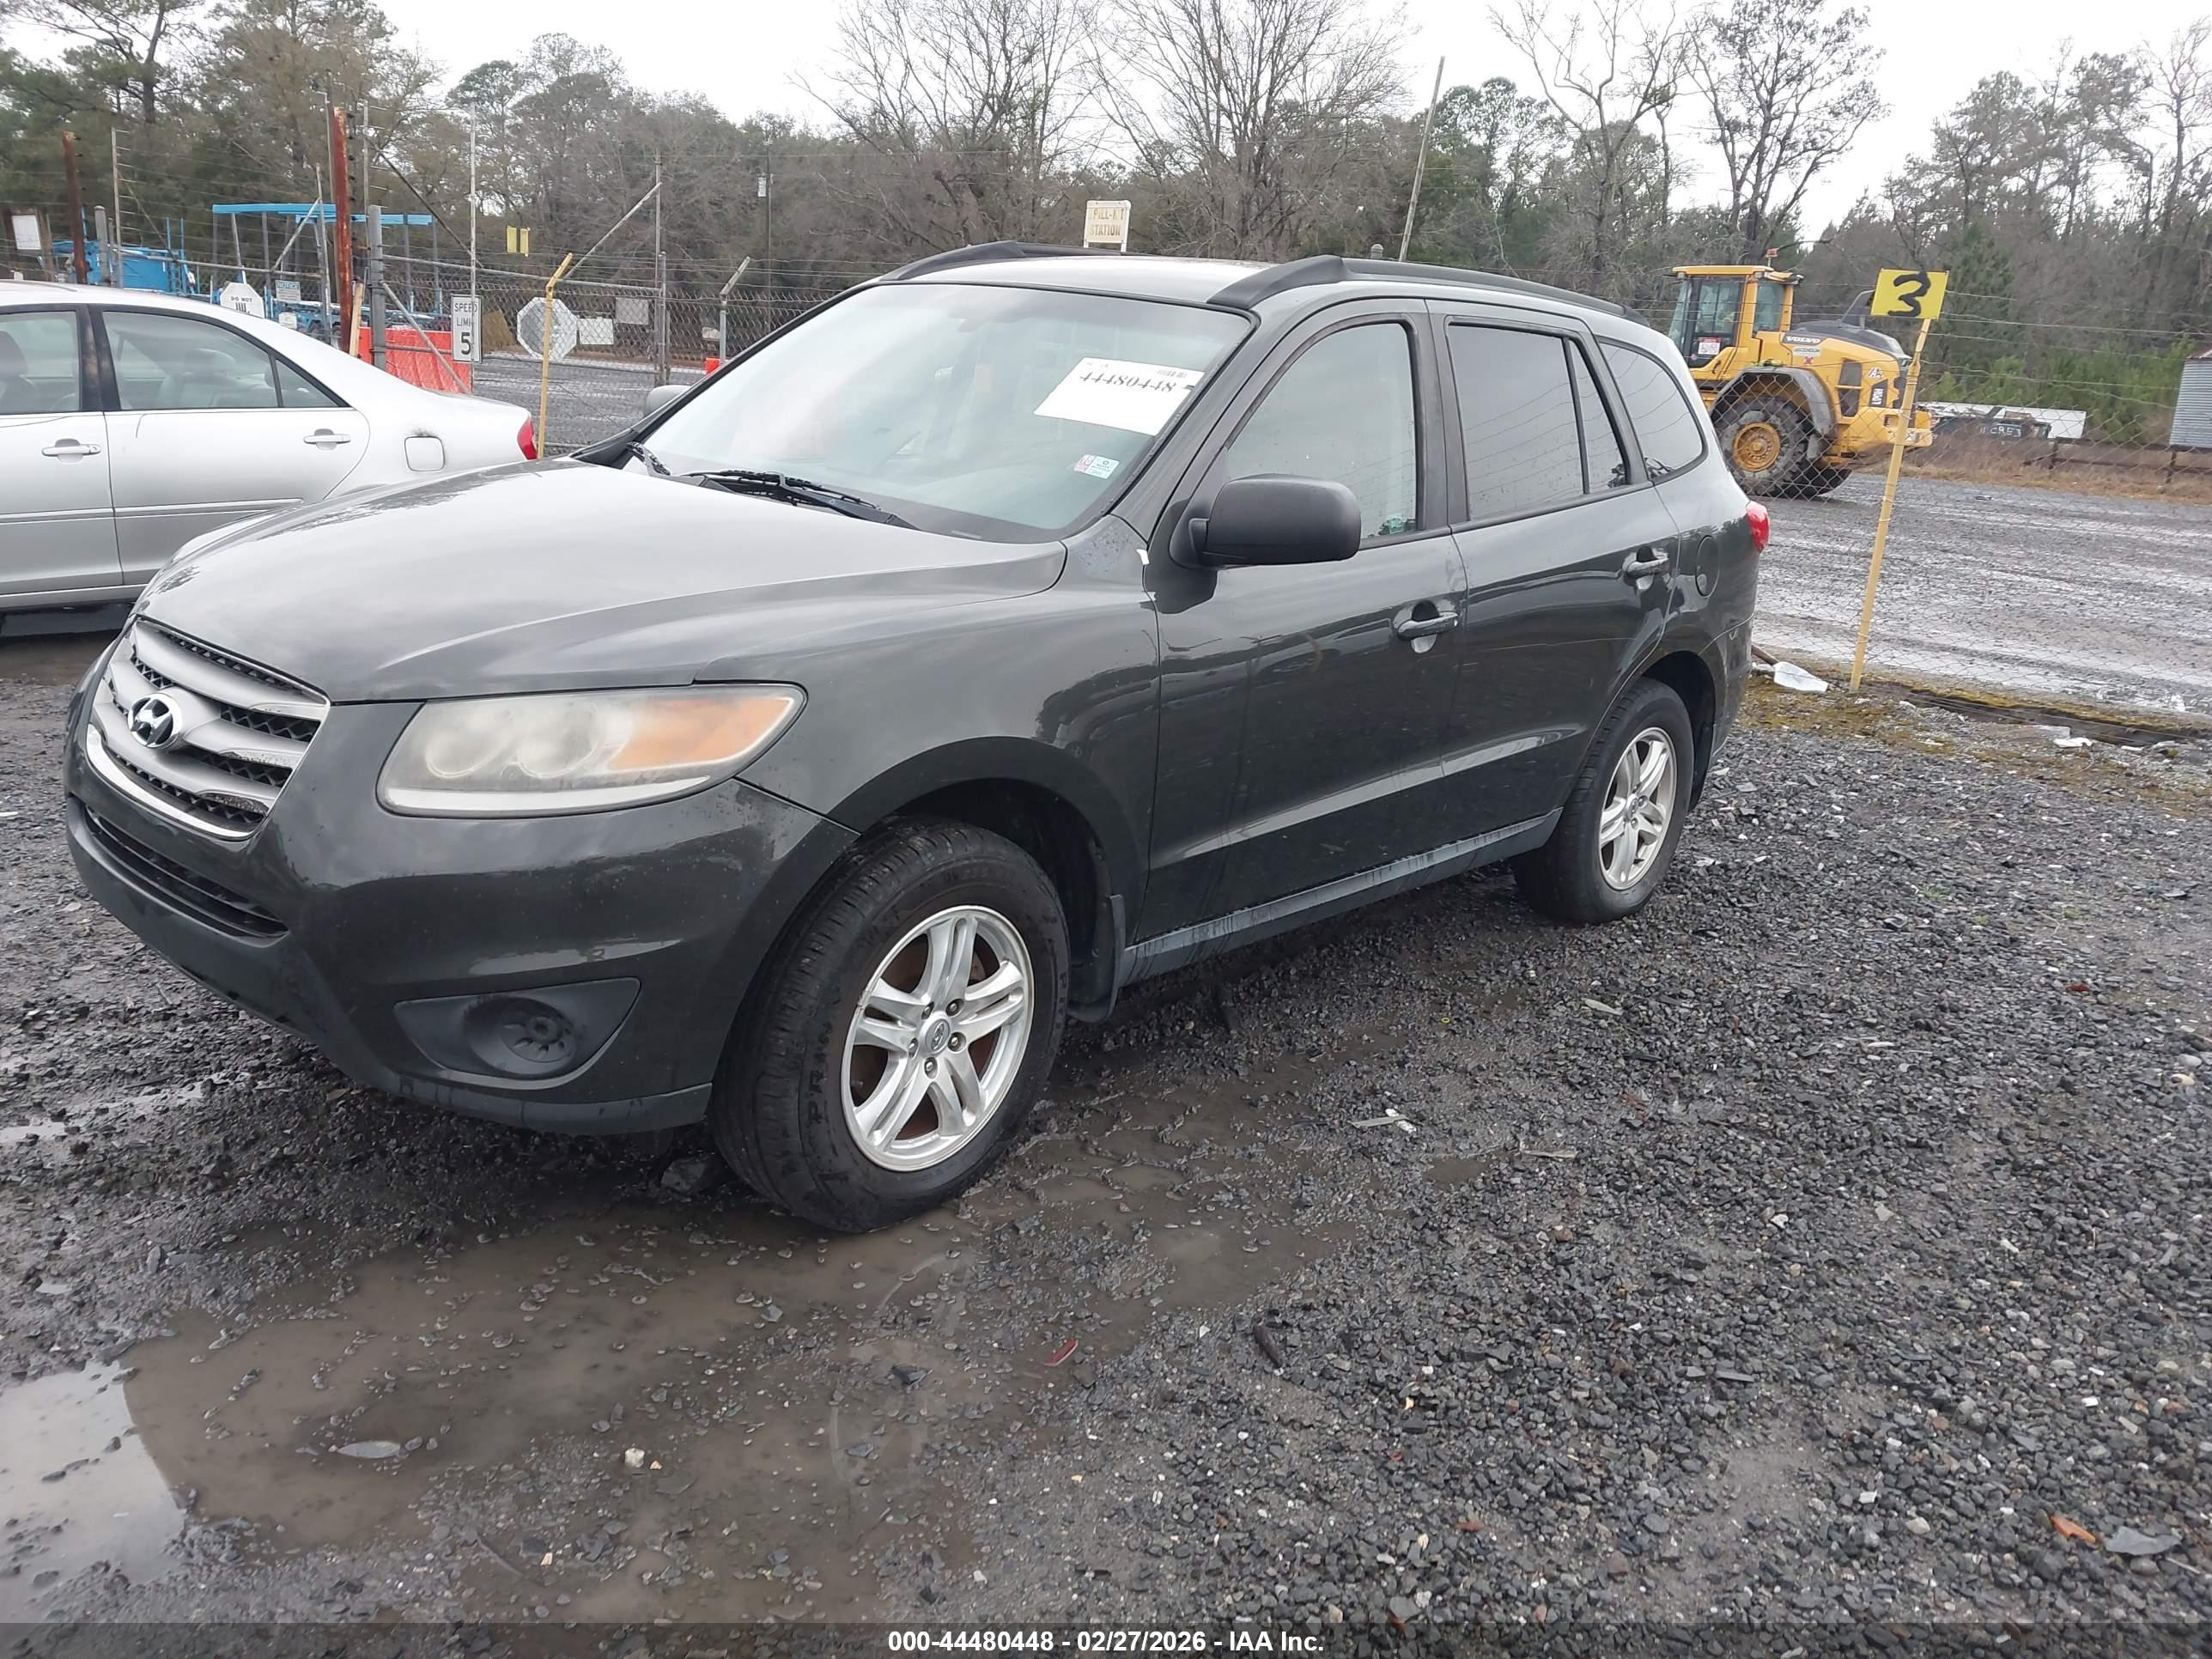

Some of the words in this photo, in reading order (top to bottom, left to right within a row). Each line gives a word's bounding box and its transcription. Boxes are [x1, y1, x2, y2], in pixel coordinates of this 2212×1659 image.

[1091, 223, 1121, 236] STATION
[1888, 270, 1931, 318] 3
[454, 302, 478, 313] SPEED
[456, 318, 473, 327] LIMI
[460, 331, 471, 356] 5
[1079, 371, 1177, 392] 44480448
